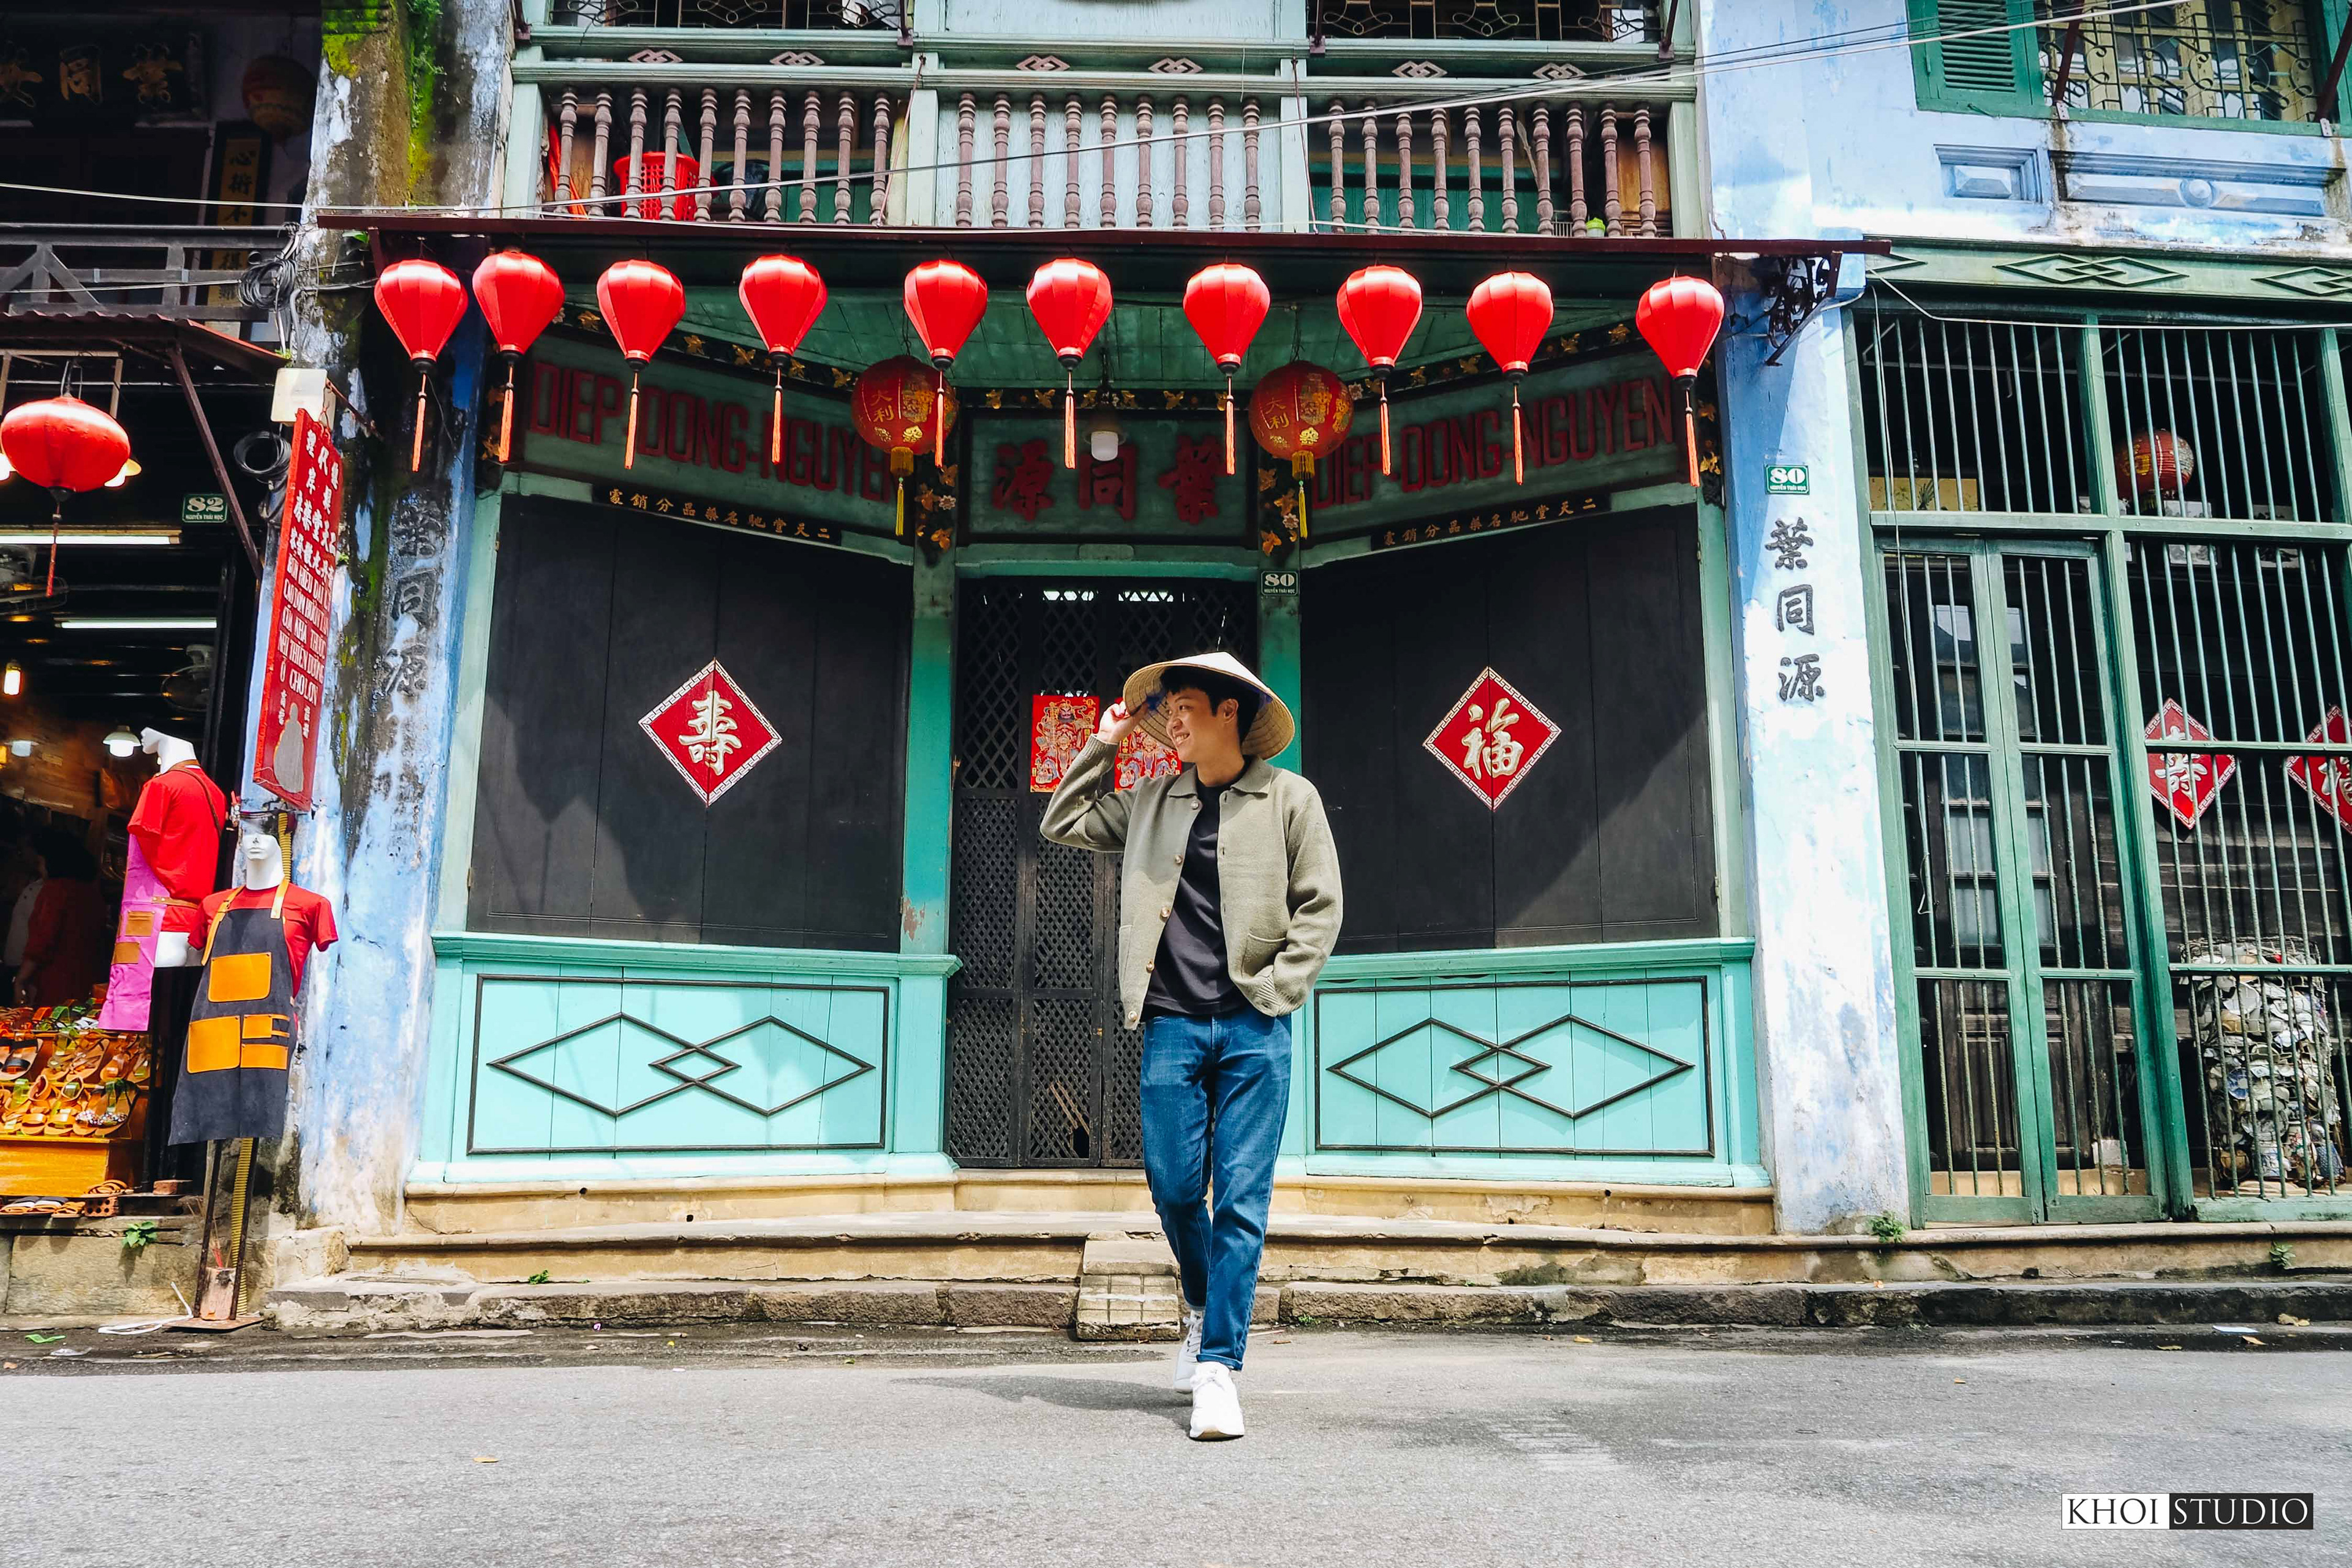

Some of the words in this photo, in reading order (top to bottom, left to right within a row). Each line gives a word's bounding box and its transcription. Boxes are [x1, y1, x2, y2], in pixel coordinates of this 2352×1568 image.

[1770, 467, 1806, 484] 80
[187, 497, 224, 512] 82
[1265, 573, 1295, 587] 80
[678, 689, 742, 776] 壽
[1461, 698, 1525, 780] 福
